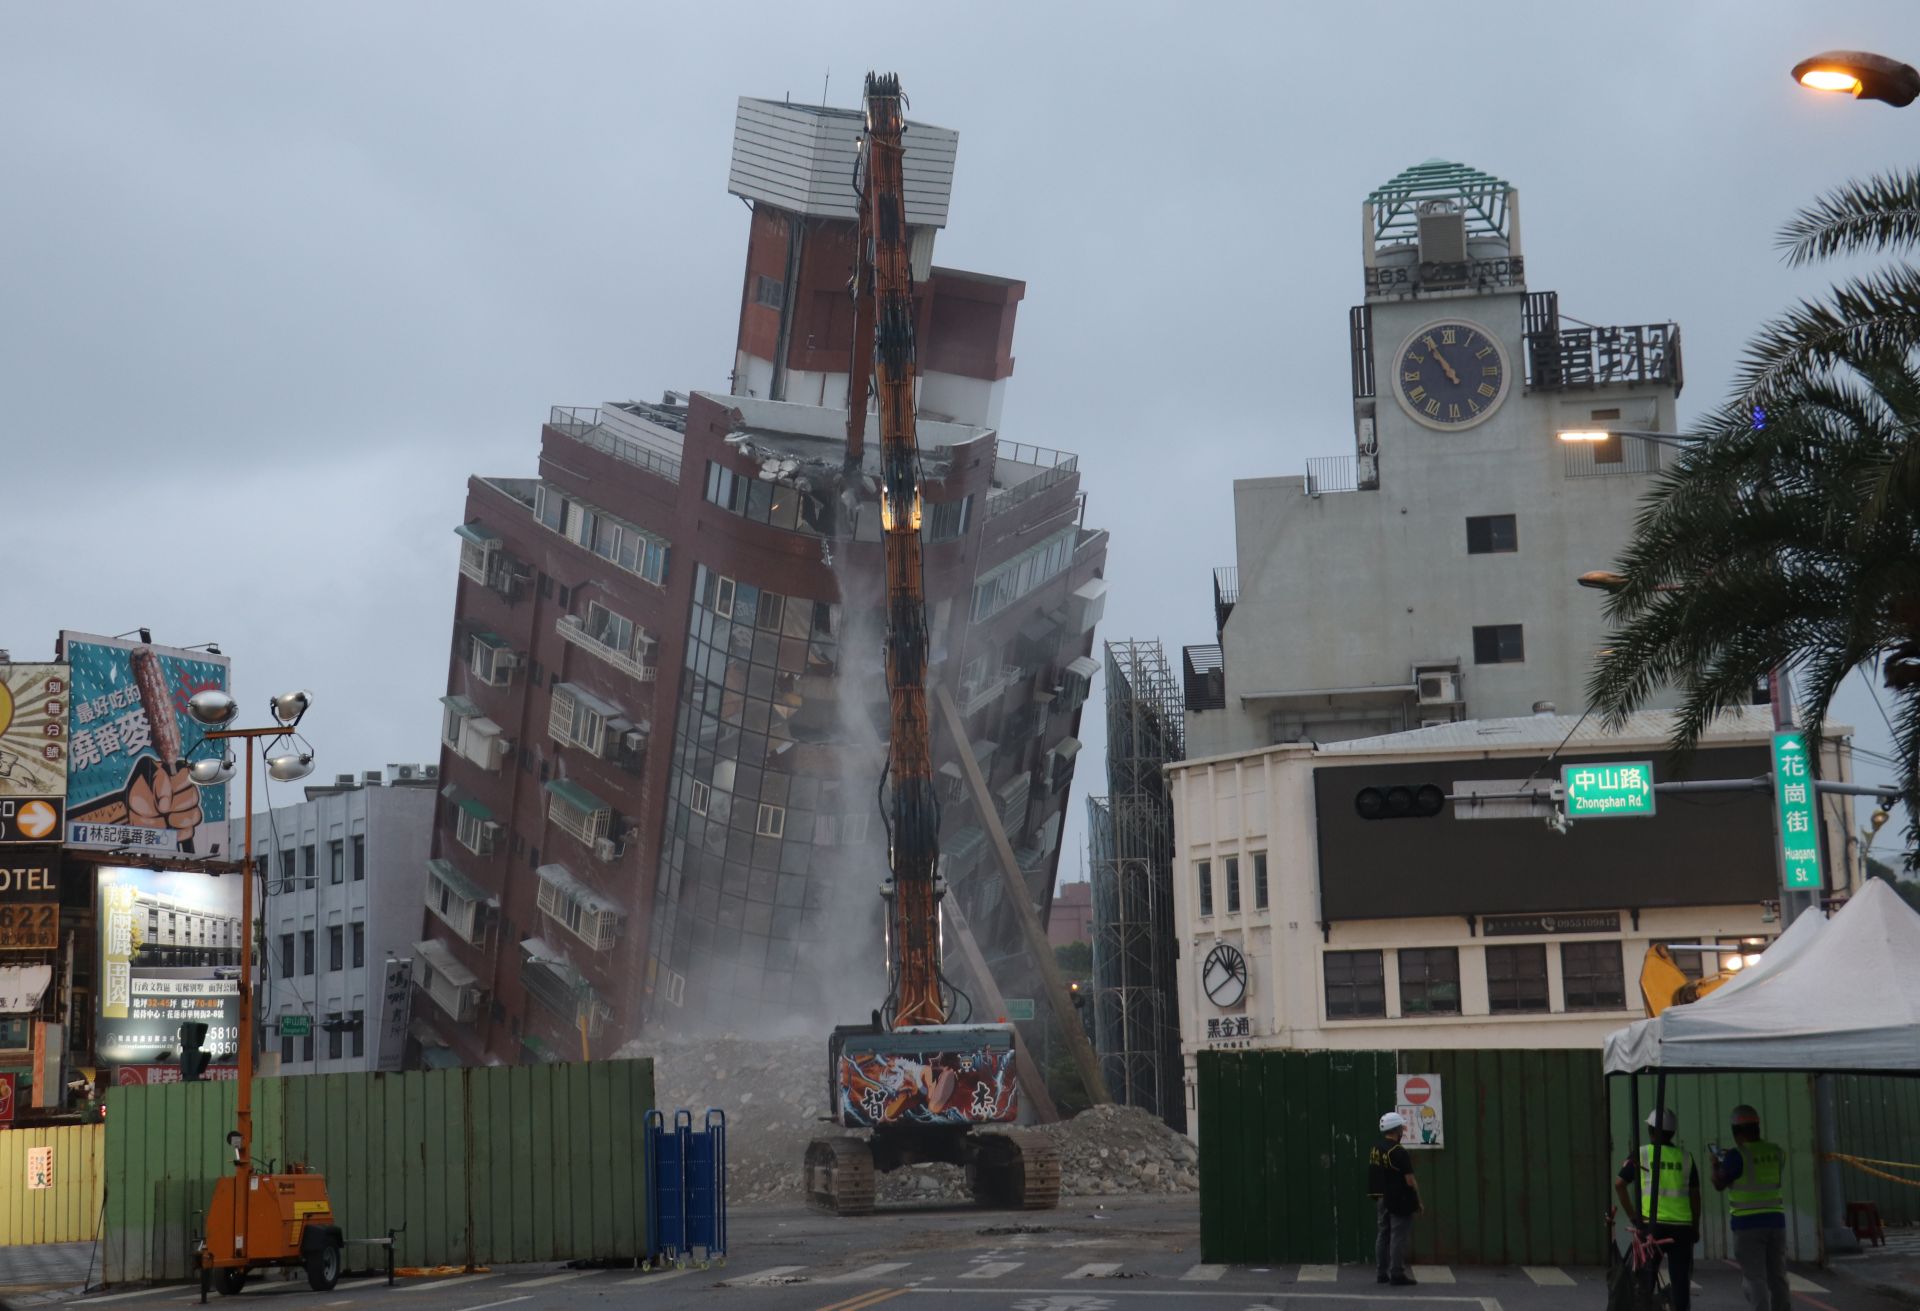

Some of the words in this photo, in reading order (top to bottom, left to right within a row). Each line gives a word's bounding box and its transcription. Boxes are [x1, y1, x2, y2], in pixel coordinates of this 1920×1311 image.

[1442, 330, 1456, 344] XII
[76, 683, 142, 724] 最好吃的
[46, 681, 61, 758] 別無分號
[1575, 768, 1641, 791] 中山路
[1576, 795, 1626, 812] Zhongshan
[1628, 794, 1644, 807] Rd.
[1781, 754, 1809, 833] 花崗街
[1785, 847, 1816, 863] Huagang
[134, 982, 170, 993] 行政文教區
[1208, 1017, 1249, 1038] 黑金通
[862, 1087, 887, 1119] 智
[972, 1082, 997, 1116] 杰
